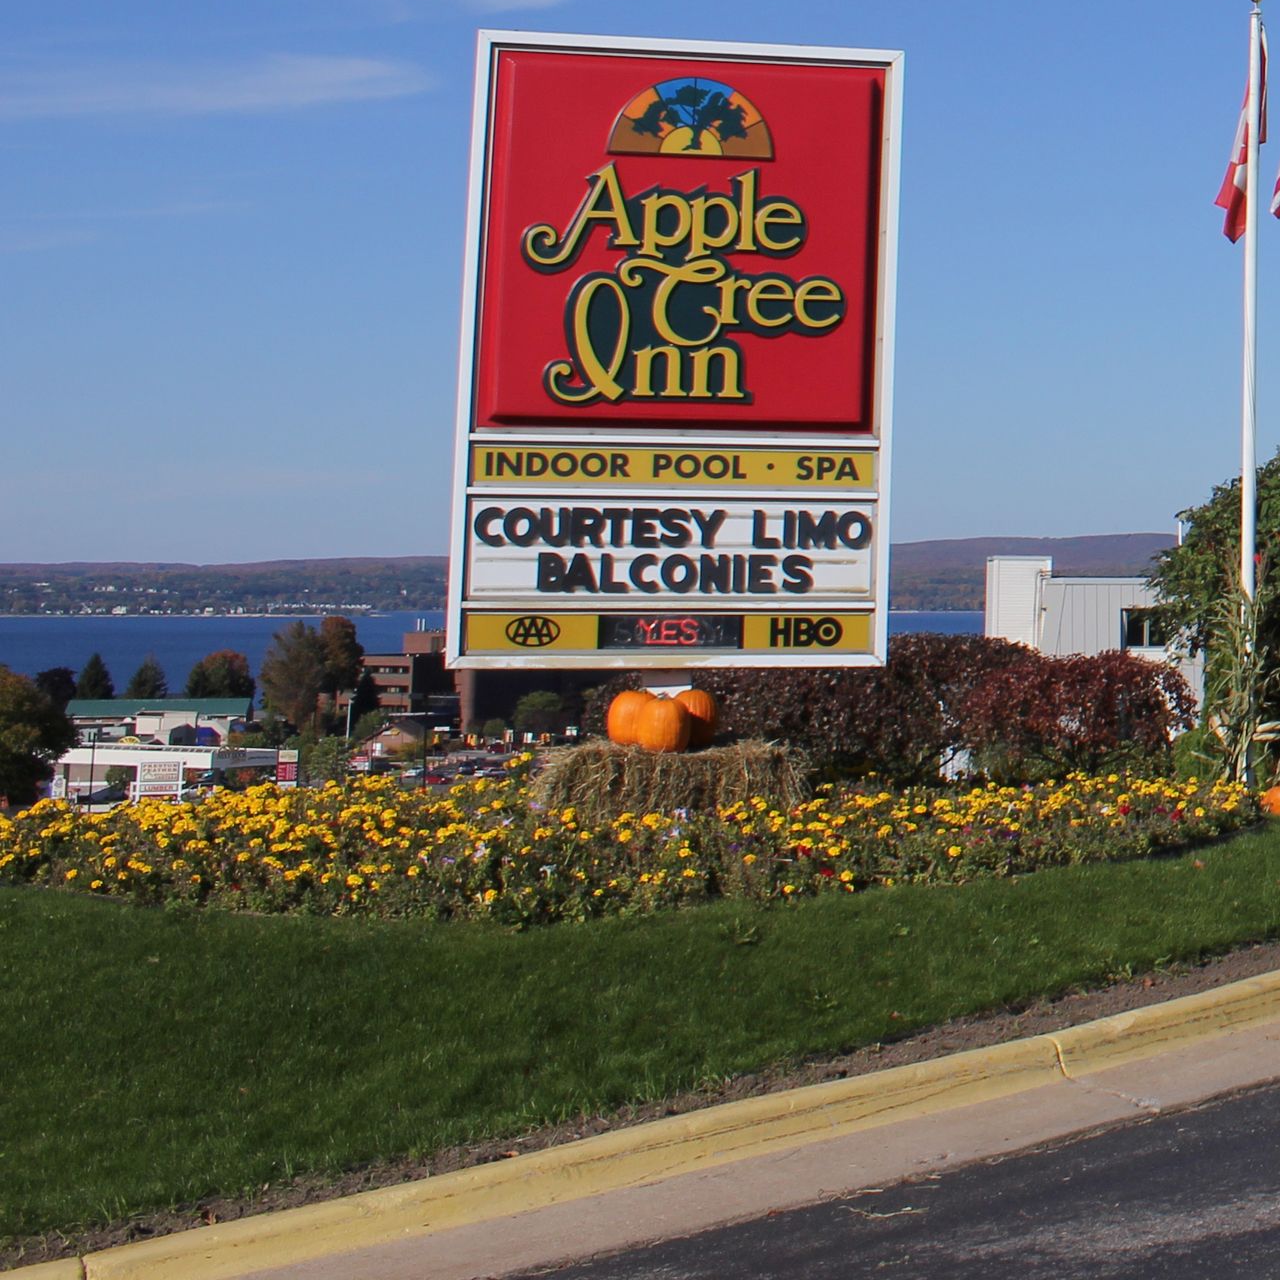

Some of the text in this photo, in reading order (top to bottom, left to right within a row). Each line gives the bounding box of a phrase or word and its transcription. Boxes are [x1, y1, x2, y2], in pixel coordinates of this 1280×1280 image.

[525, 163, 803, 264] Apple
[619, 258, 842, 347] Tree
[550, 277, 745, 401] Inn
[485, 451, 860, 481] INDOOR POOL SPA
[474, 506, 873, 550] COURTESY LIMO
[537, 552, 814, 594] BALCONIES
[509, 616, 558, 647] AAA
[638, 618, 699, 645] YES
[769, 616, 843, 647] HBO
